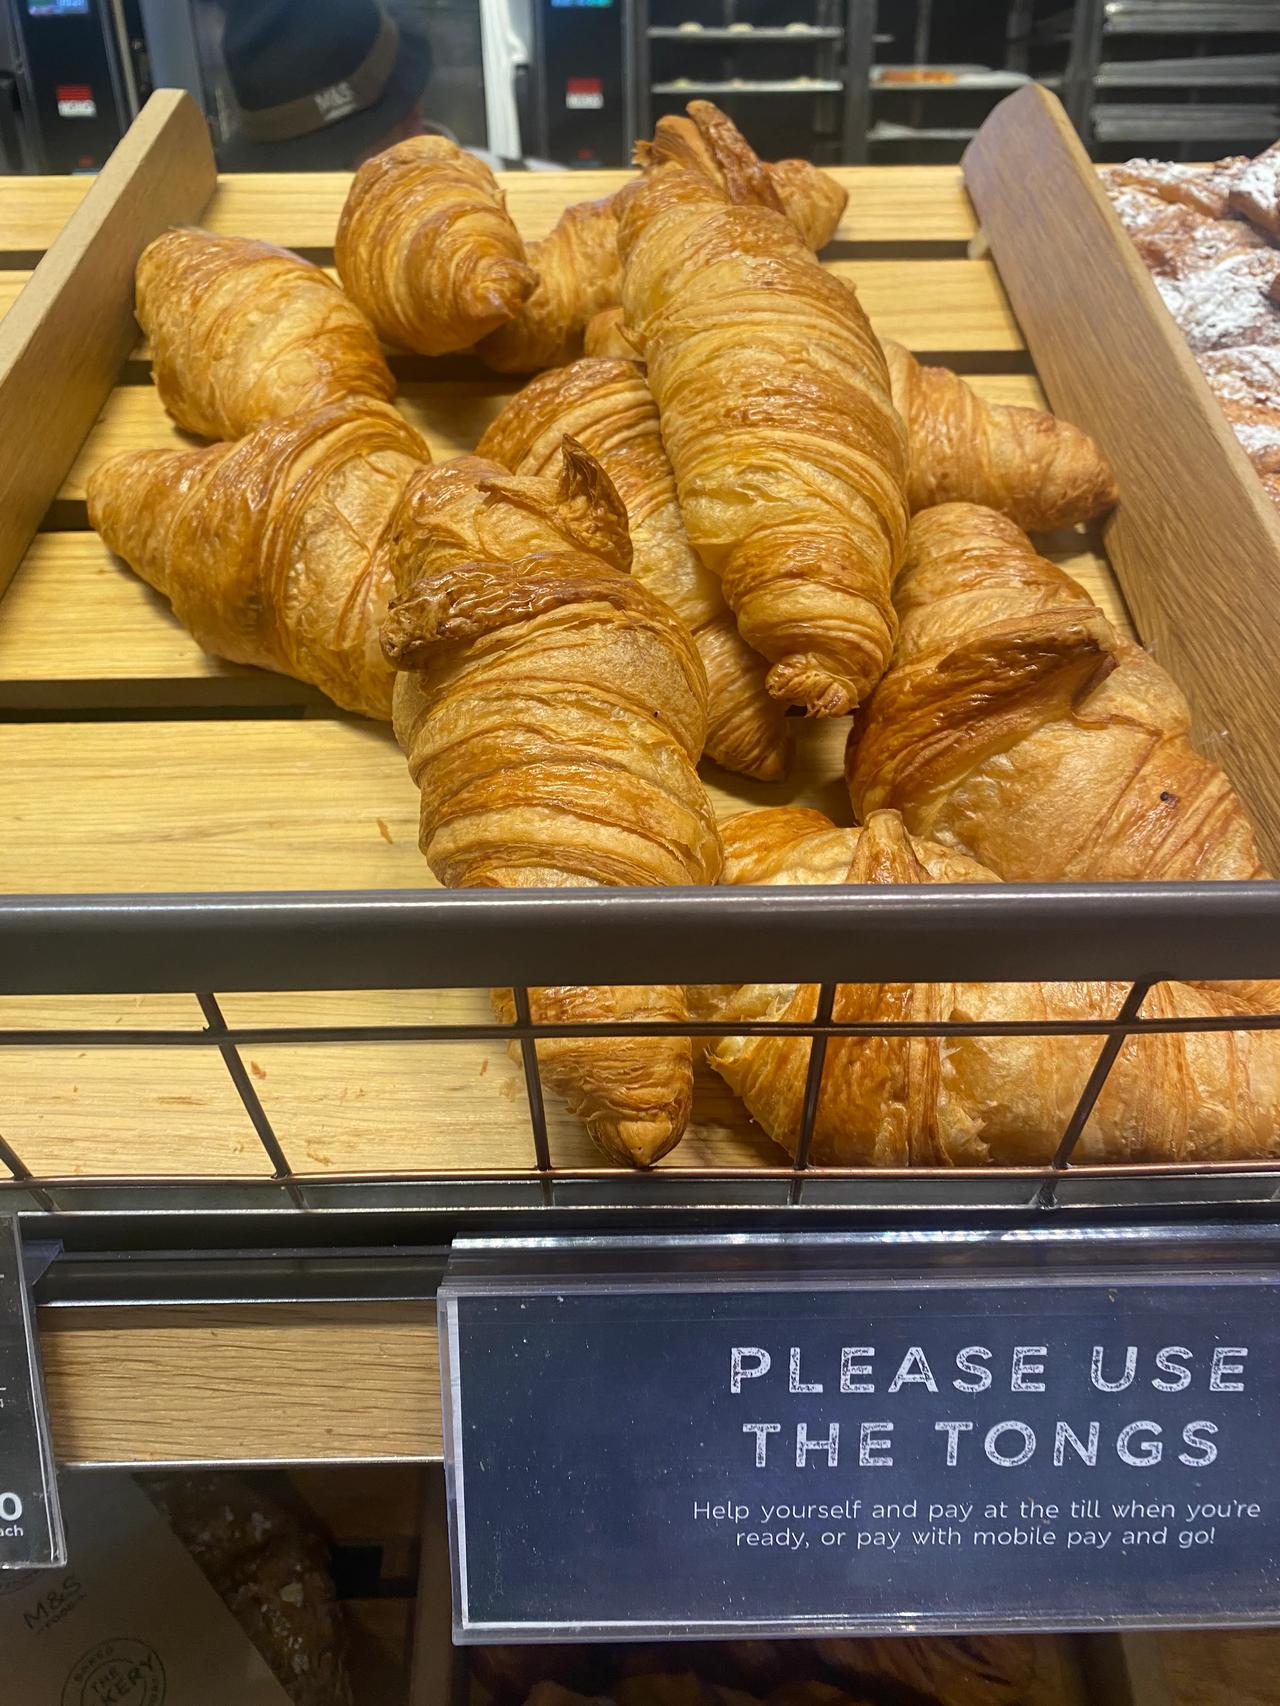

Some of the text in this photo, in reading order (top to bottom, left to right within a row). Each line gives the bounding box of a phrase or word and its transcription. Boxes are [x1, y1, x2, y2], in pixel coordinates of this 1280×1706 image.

[730, 1346, 1248, 1393] PLEASE USE
[742, 1420, 1219, 1468] THE TONGS
[693, 1500, 1261, 1524] Help yourself and pay at the till when you're
[736, 1526, 1216, 1550] ready, or pay with mobile pay and go!
[23, 1576, 82, 1630] M&S
